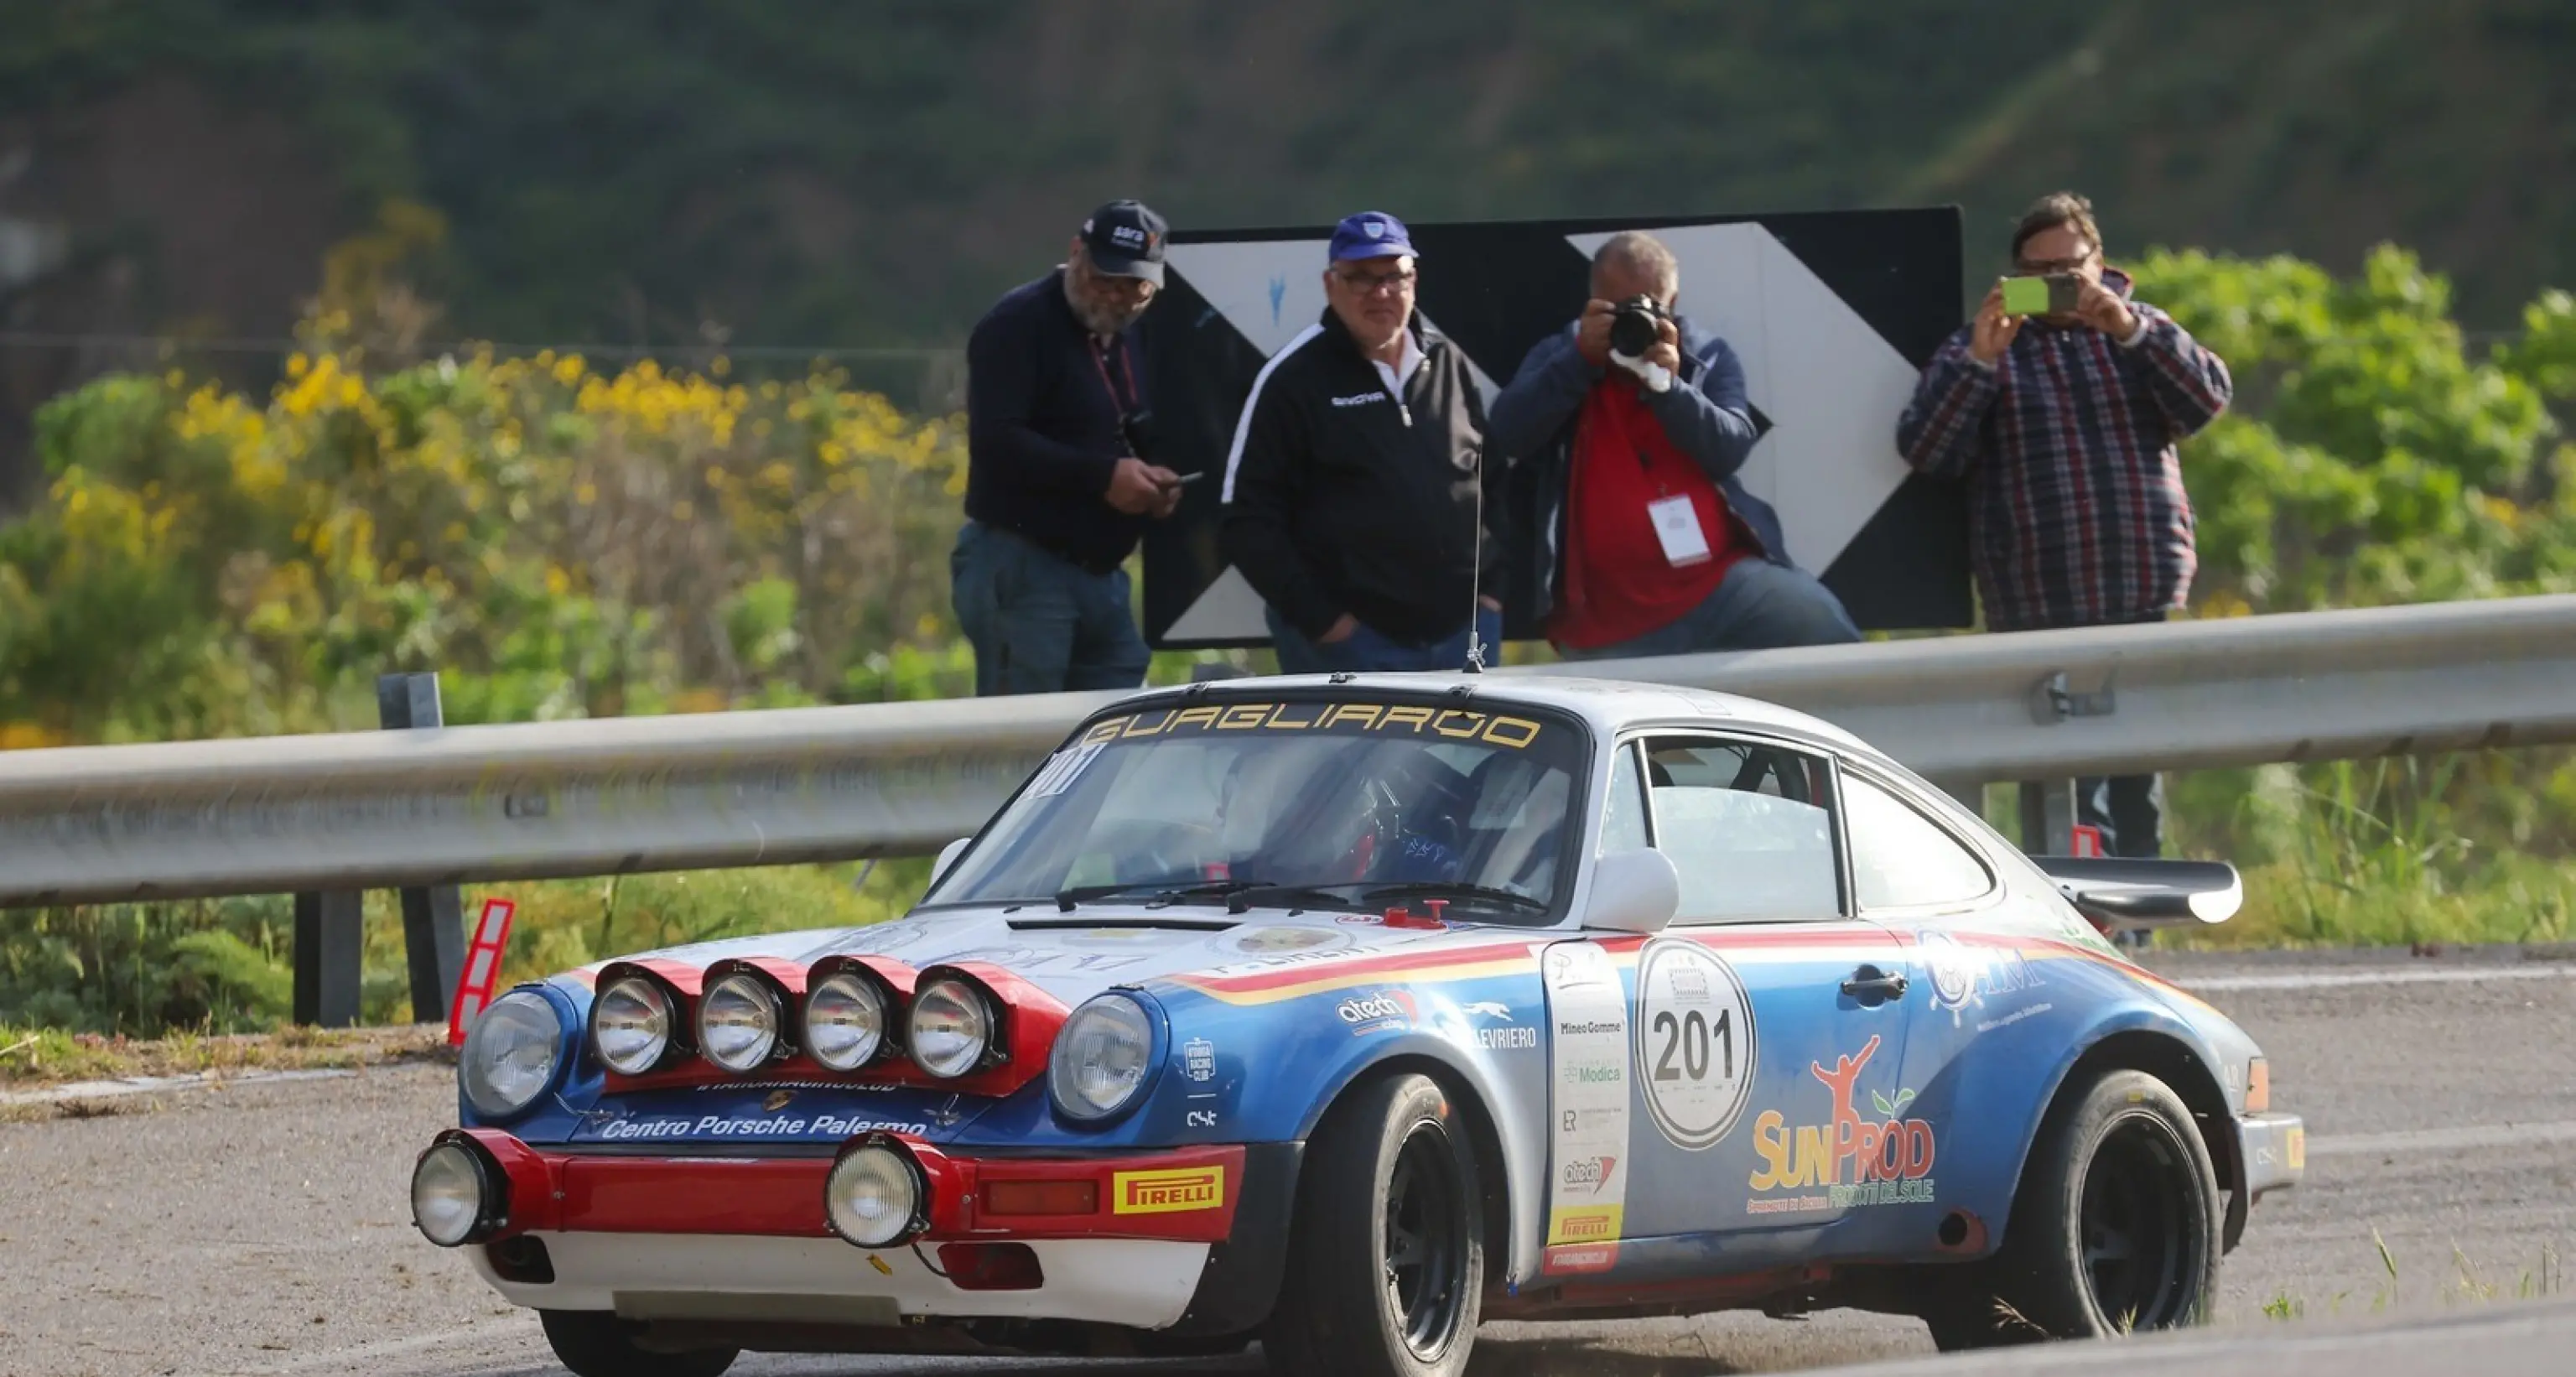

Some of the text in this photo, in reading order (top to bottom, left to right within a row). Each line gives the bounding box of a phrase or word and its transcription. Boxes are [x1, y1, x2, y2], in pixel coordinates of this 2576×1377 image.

[1083, 703, 1541, 749] GUAGLIARDO
[1561, 1021, 1622, 1035] Mineo Gomme
[1654, 1008, 1733, 1082] 201
[1579, 1067, 1621, 1083] Modica
[601, 1115, 927, 1140] Centro Porsche Palermo
[1126, 1174, 1215, 1206] PIRELLI
[1561, 1215, 1610, 1235] PIRELLI
